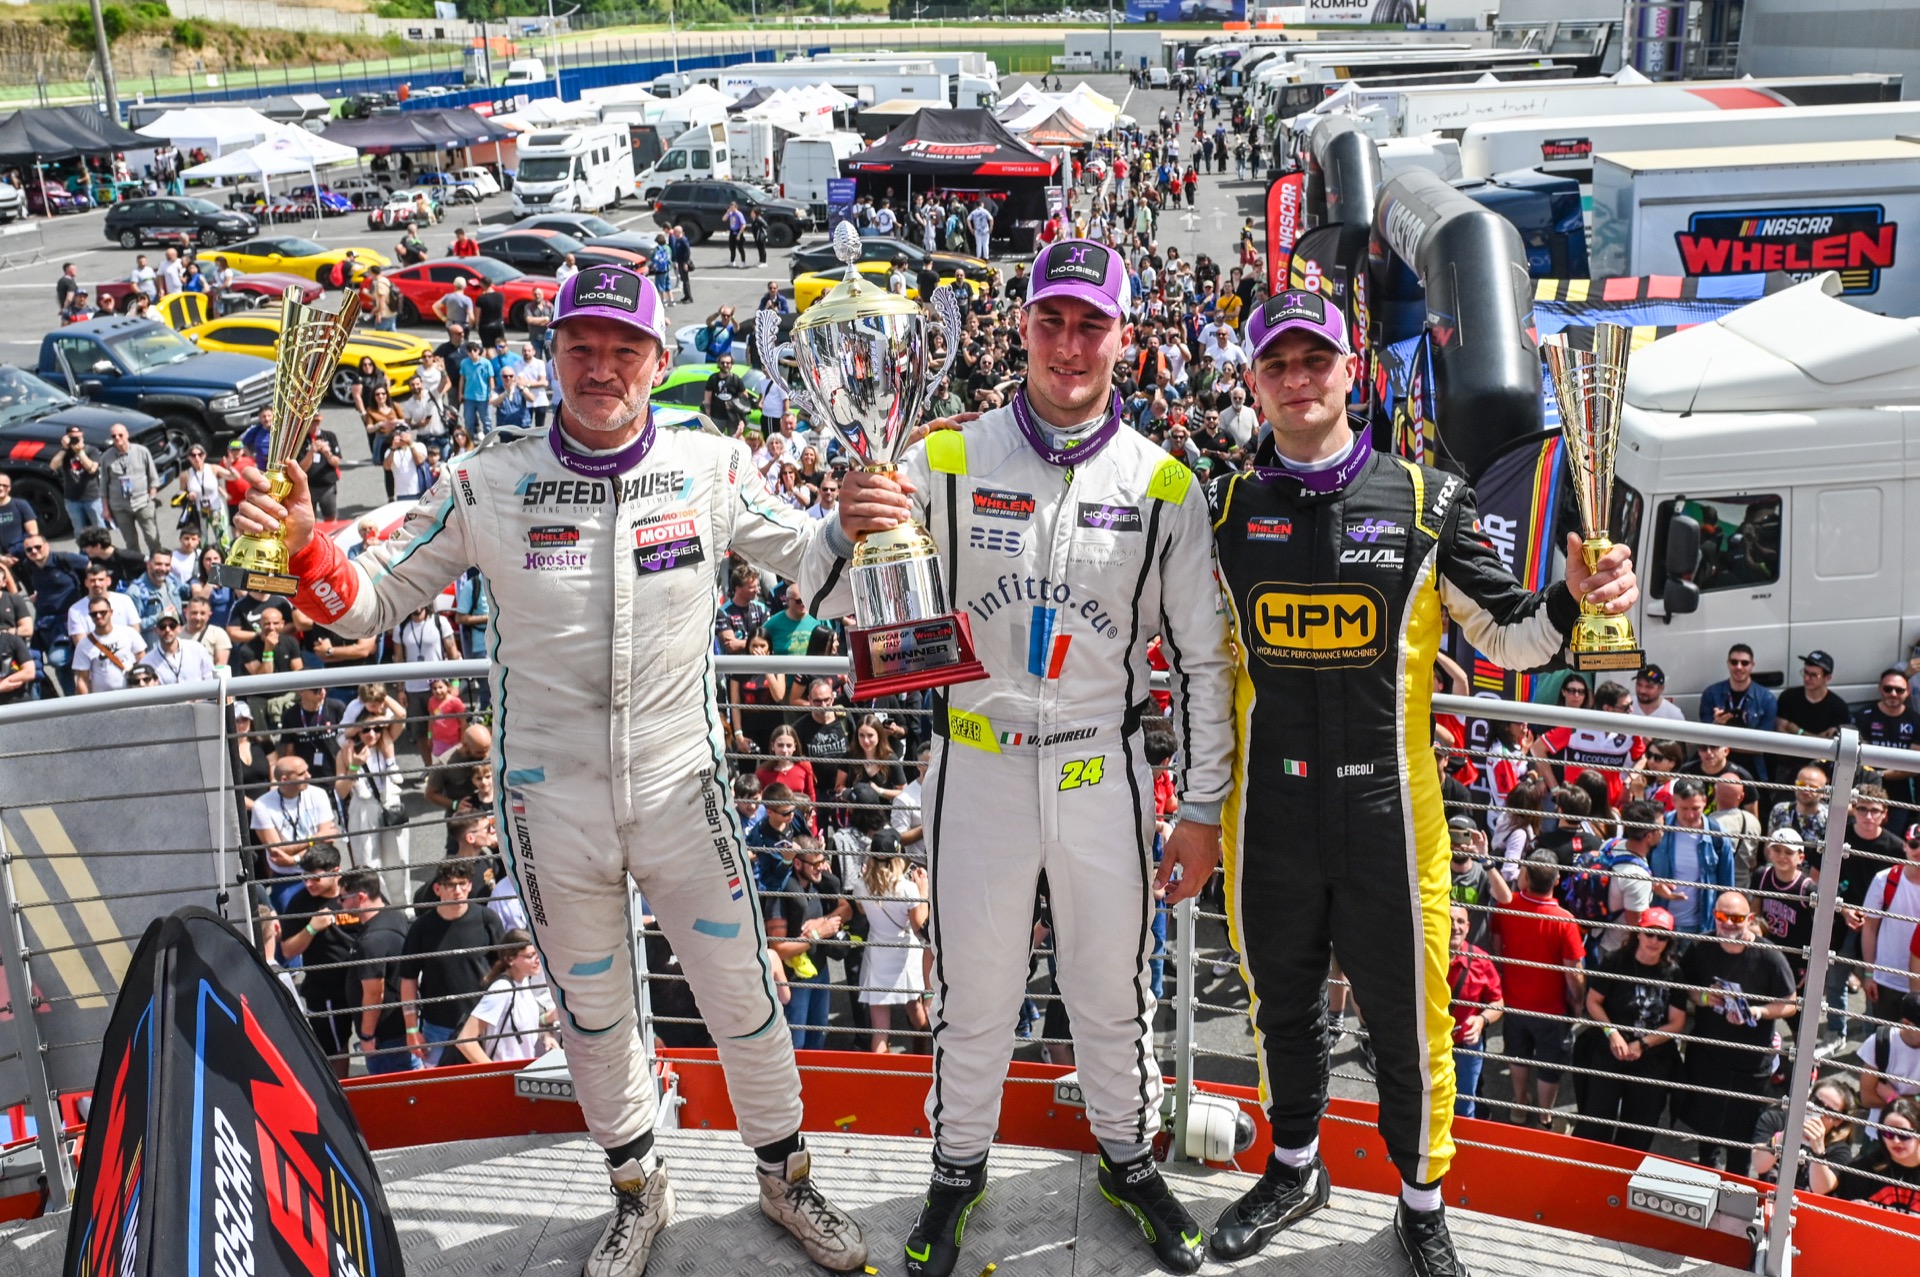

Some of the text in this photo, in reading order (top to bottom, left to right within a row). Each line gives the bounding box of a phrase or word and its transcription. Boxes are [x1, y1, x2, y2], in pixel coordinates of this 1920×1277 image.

[1433, 103, 1470, 125] speed
[1475, 106, 1493, 114] we
[1500, 98, 1534, 111] trust
[1279, 183, 1297, 249] NASCAR
[1761, 216, 1834, 237] NASCAR
[1678, 224, 1895, 273] WHELEN
[1051, 265, 1100, 279] HOOSIER
[579, 292, 632, 306] HOOSIER
[1270, 308, 1320, 322] HOOSIER
[1062, 437, 1102, 461] HOOSIER
[1346, 444, 1368, 474] HOOSIER
[570, 460, 617, 471] HOOSIER
[523, 480, 606, 506] SPEED
[973, 492, 1036, 513] WHELEN
[1433, 475, 1459, 518] HRX
[522, 506, 560, 514] RACING
[1083, 509, 1140, 523] HOOSIER
[528, 529, 580, 541] WHELEN
[638, 523, 694, 545] MOTUL
[1247, 521, 1292, 535] WHELEN
[1346, 525, 1405, 535] HOOSIER
[523, 550, 587, 571] Hoosier
[638, 544, 701, 564] HOOSIER
[1261, 602, 1369, 639] HPM
[872, 632, 899, 644] NASCAR
[879, 644, 949, 663] WINNER
[1257, 646, 1378, 661] HYDRAULIC PERFORMANCE MACHINES
[951, 715, 982, 734] SPEED
[951, 725, 982, 742] WEAR
[1043, 726, 1098, 746] GHIRELLI
[1058, 755, 1105, 791] 24
[699, 767, 738, 878] LUCAS LASSERRE
[514, 815, 549, 927] LUCAS LASSERRE
[1767, 912, 1789, 938] 23
